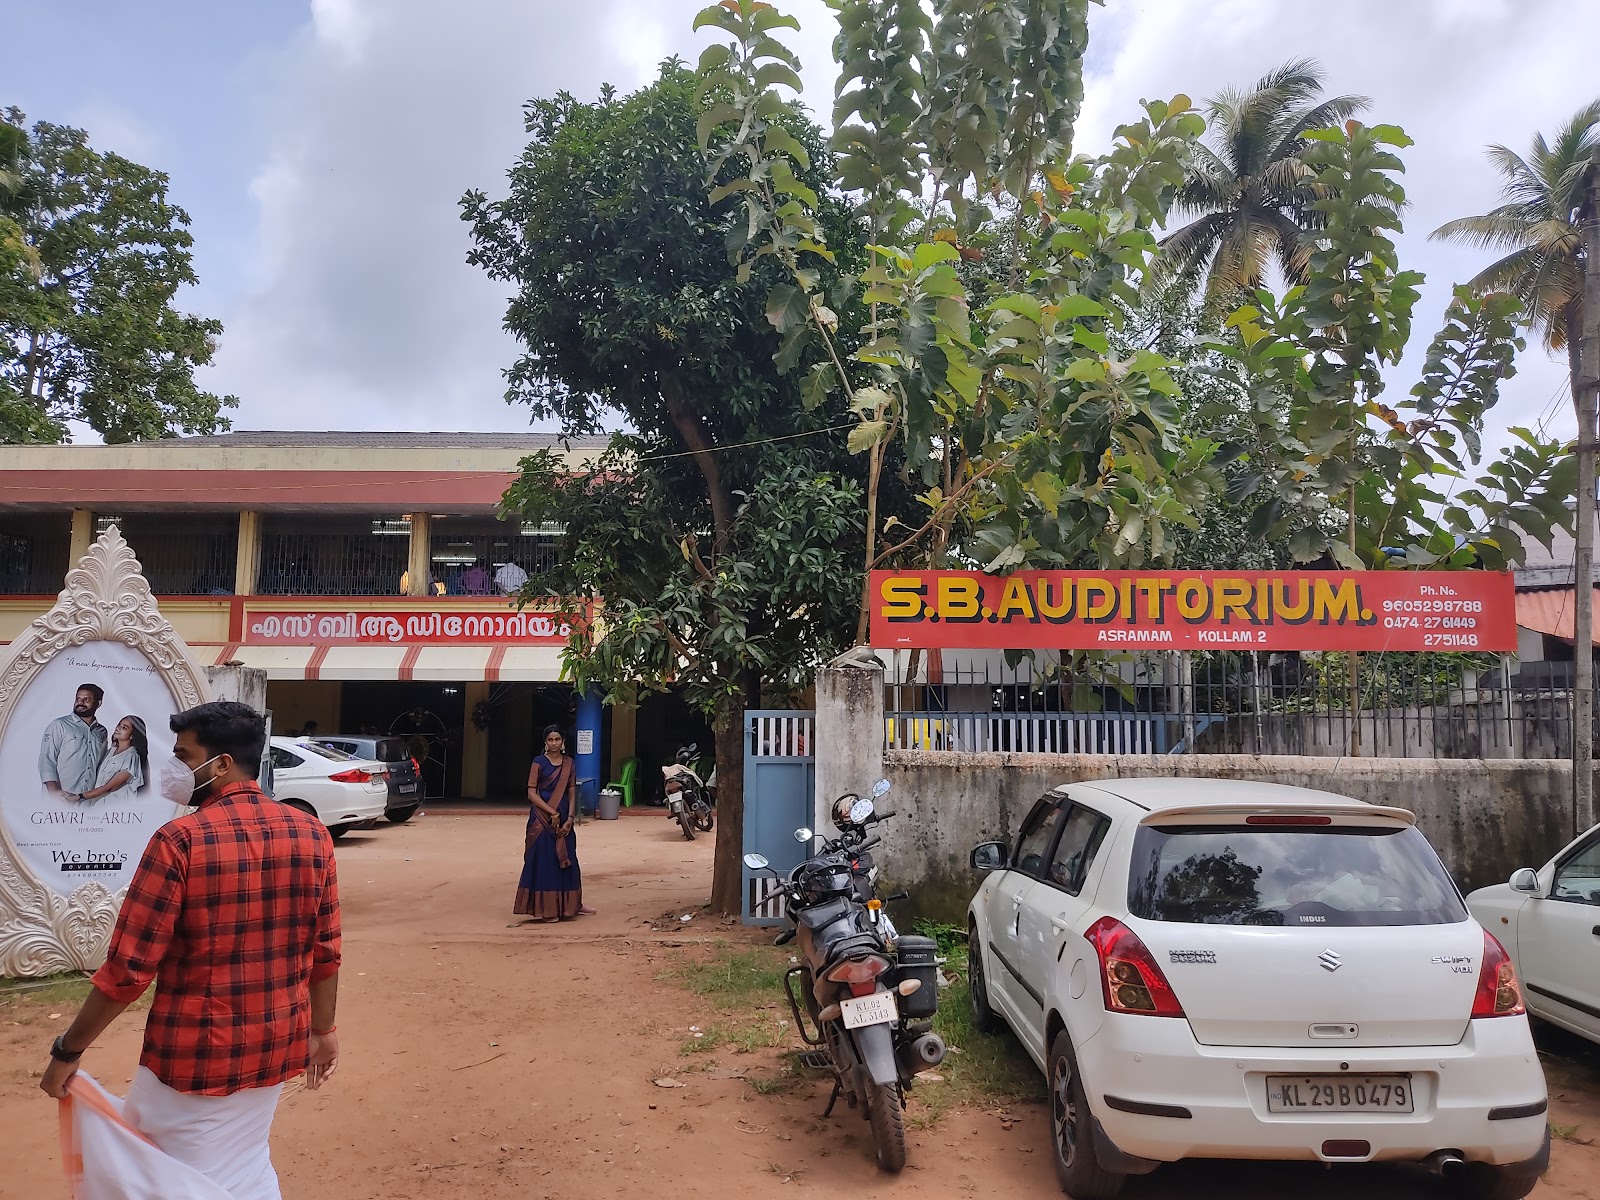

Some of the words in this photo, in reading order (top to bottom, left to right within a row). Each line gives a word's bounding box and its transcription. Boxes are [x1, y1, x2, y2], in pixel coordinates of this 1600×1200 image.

[1382, 600, 1482, 613] 9605298788
[1097, 630, 1173, 642] ASRAMAM
[1424, 634, 1478, 646] 2751148
[91, 659, 124, 673] beginning
[30, 811, 85, 824] GAWRI
[100, 811, 143, 824] ARUN
[51, 850, 81, 863] We
[87, 849, 128, 863] bro's
[1299, 915, 1326, 923] INDUS
[1431, 955, 1474, 964] SWIFT
[869, 1008, 889, 1021] 5143
